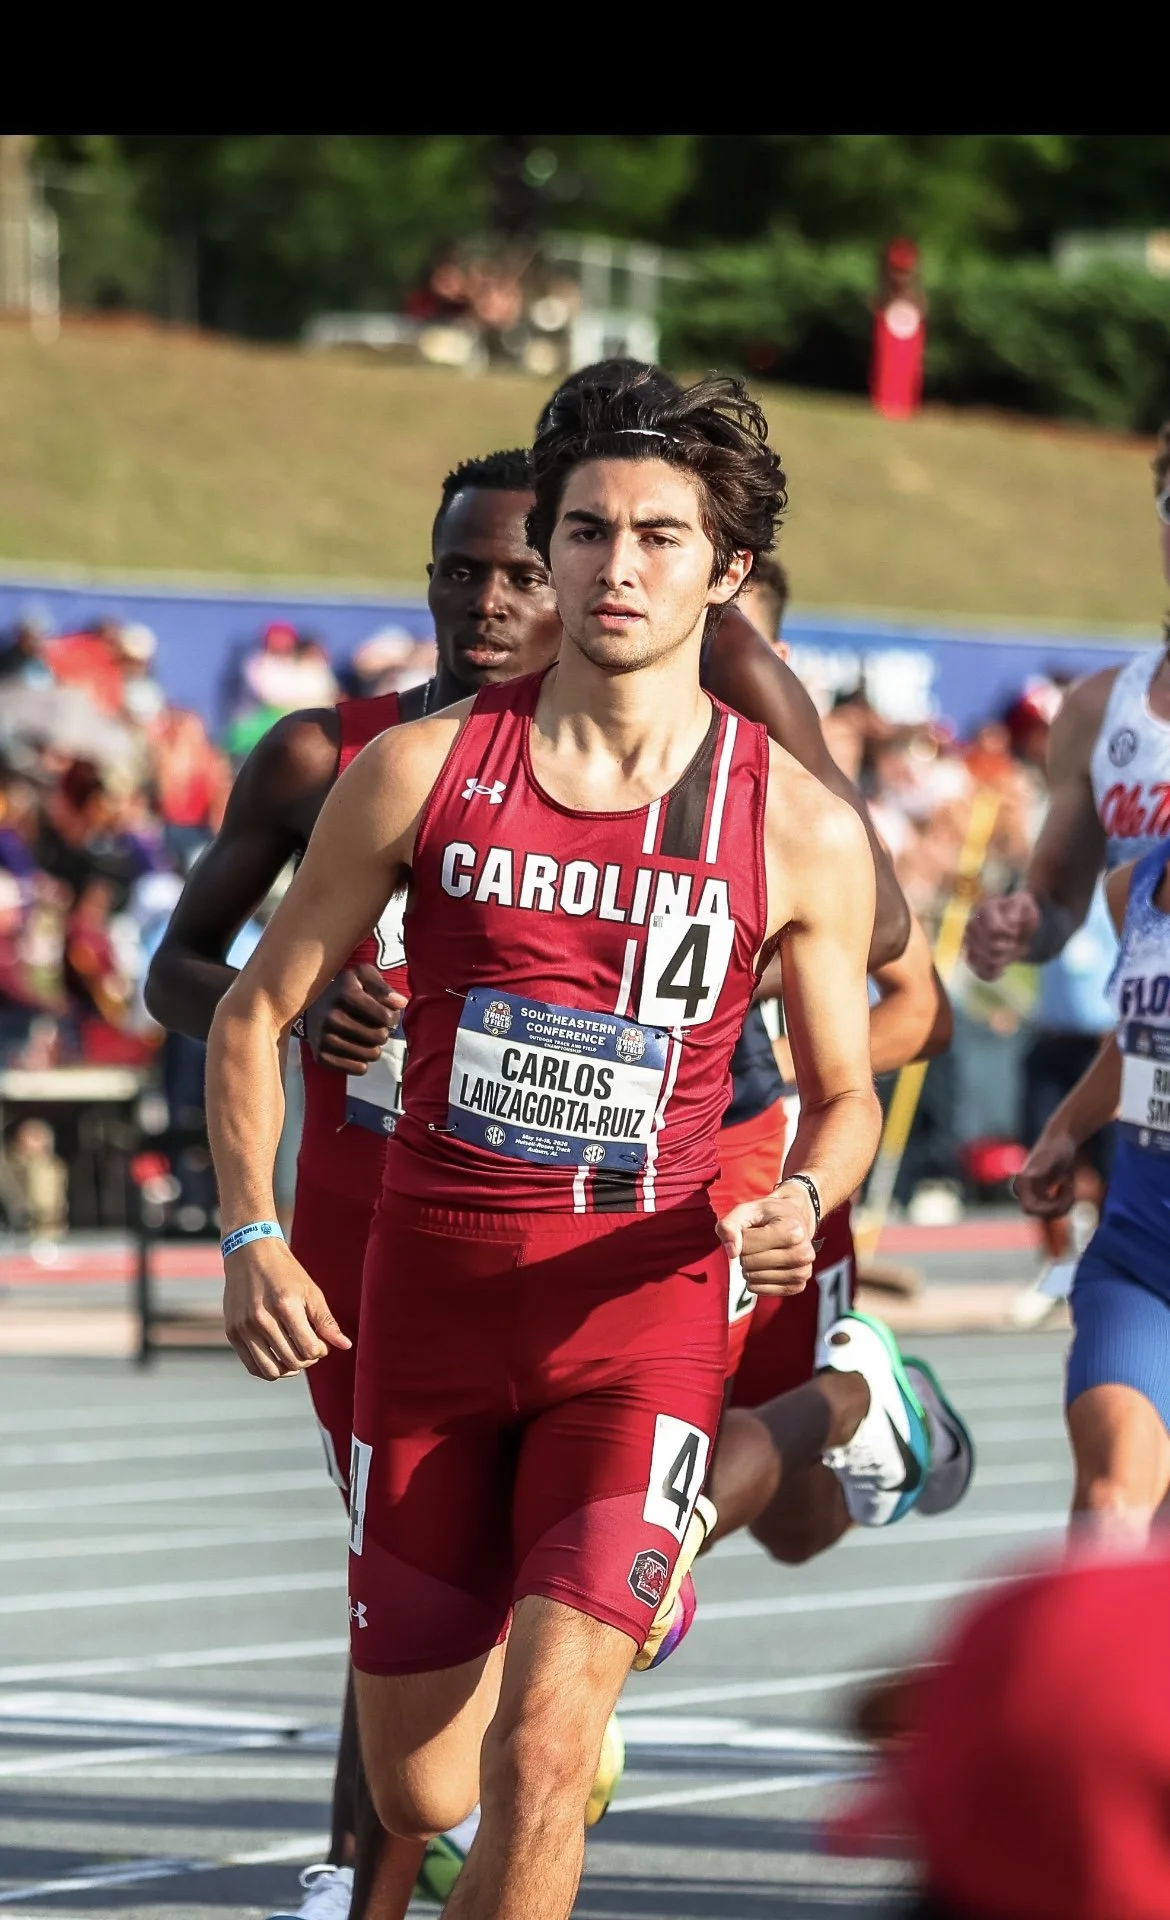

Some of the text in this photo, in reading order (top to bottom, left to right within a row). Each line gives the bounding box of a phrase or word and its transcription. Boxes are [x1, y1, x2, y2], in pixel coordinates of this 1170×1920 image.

[440, 841, 731, 925] CAROLINA
[656, 924, 710, 1019] 4
[485, 1010, 511, 1023] TRACK
[490, 1018, 510, 1029] FIELD
[520, 1007, 617, 1035] SOUTHEASTERN
[526, 1022, 606, 1046] CONFERENCE
[529, 1034, 598, 1053] OUTDOOR TRACK AND FIELD
[618, 1038, 642, 1049] TRACK
[501, 1047, 615, 1100] CARLOS
[459, 1073, 646, 1139] LANZAGORTA-RUIZ
[487, 1126, 503, 1144] SEC
[521, 1133, 535, 1142] May
[555, 1145, 571, 1153] Track
[585, 1146, 603, 1164] SEC
[662, 1432, 700, 1530] 4
